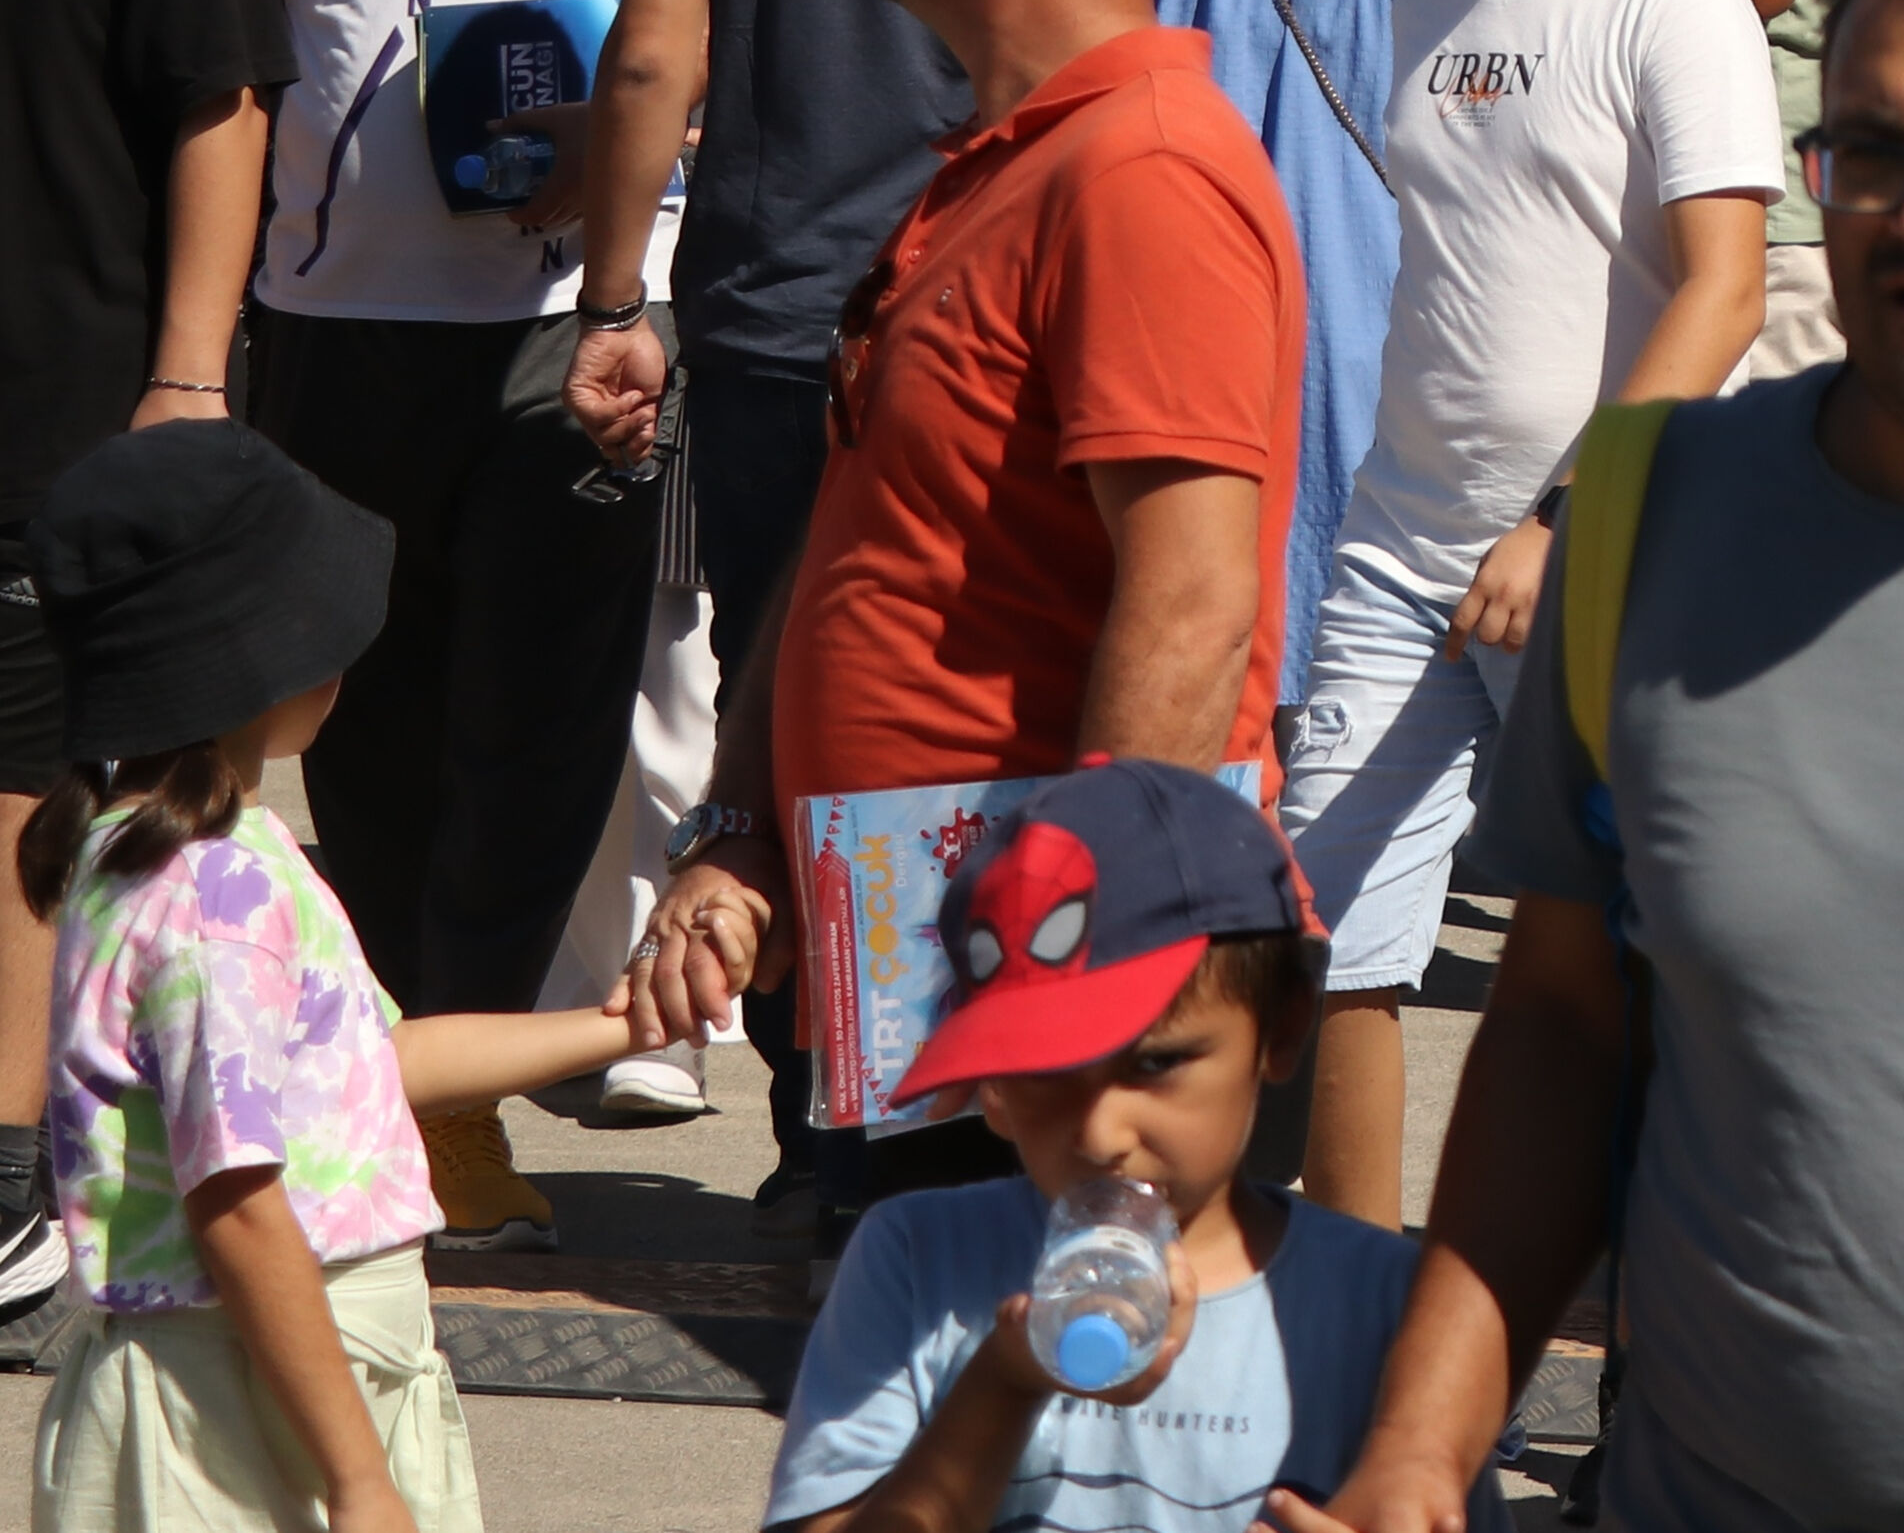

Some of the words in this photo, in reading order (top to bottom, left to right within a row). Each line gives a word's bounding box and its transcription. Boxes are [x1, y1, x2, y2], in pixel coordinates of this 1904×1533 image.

[1427, 52, 1545, 96] URBN
[869, 990, 904, 1080] TRT
[1138, 1407, 1250, 1434] HUNTERS
